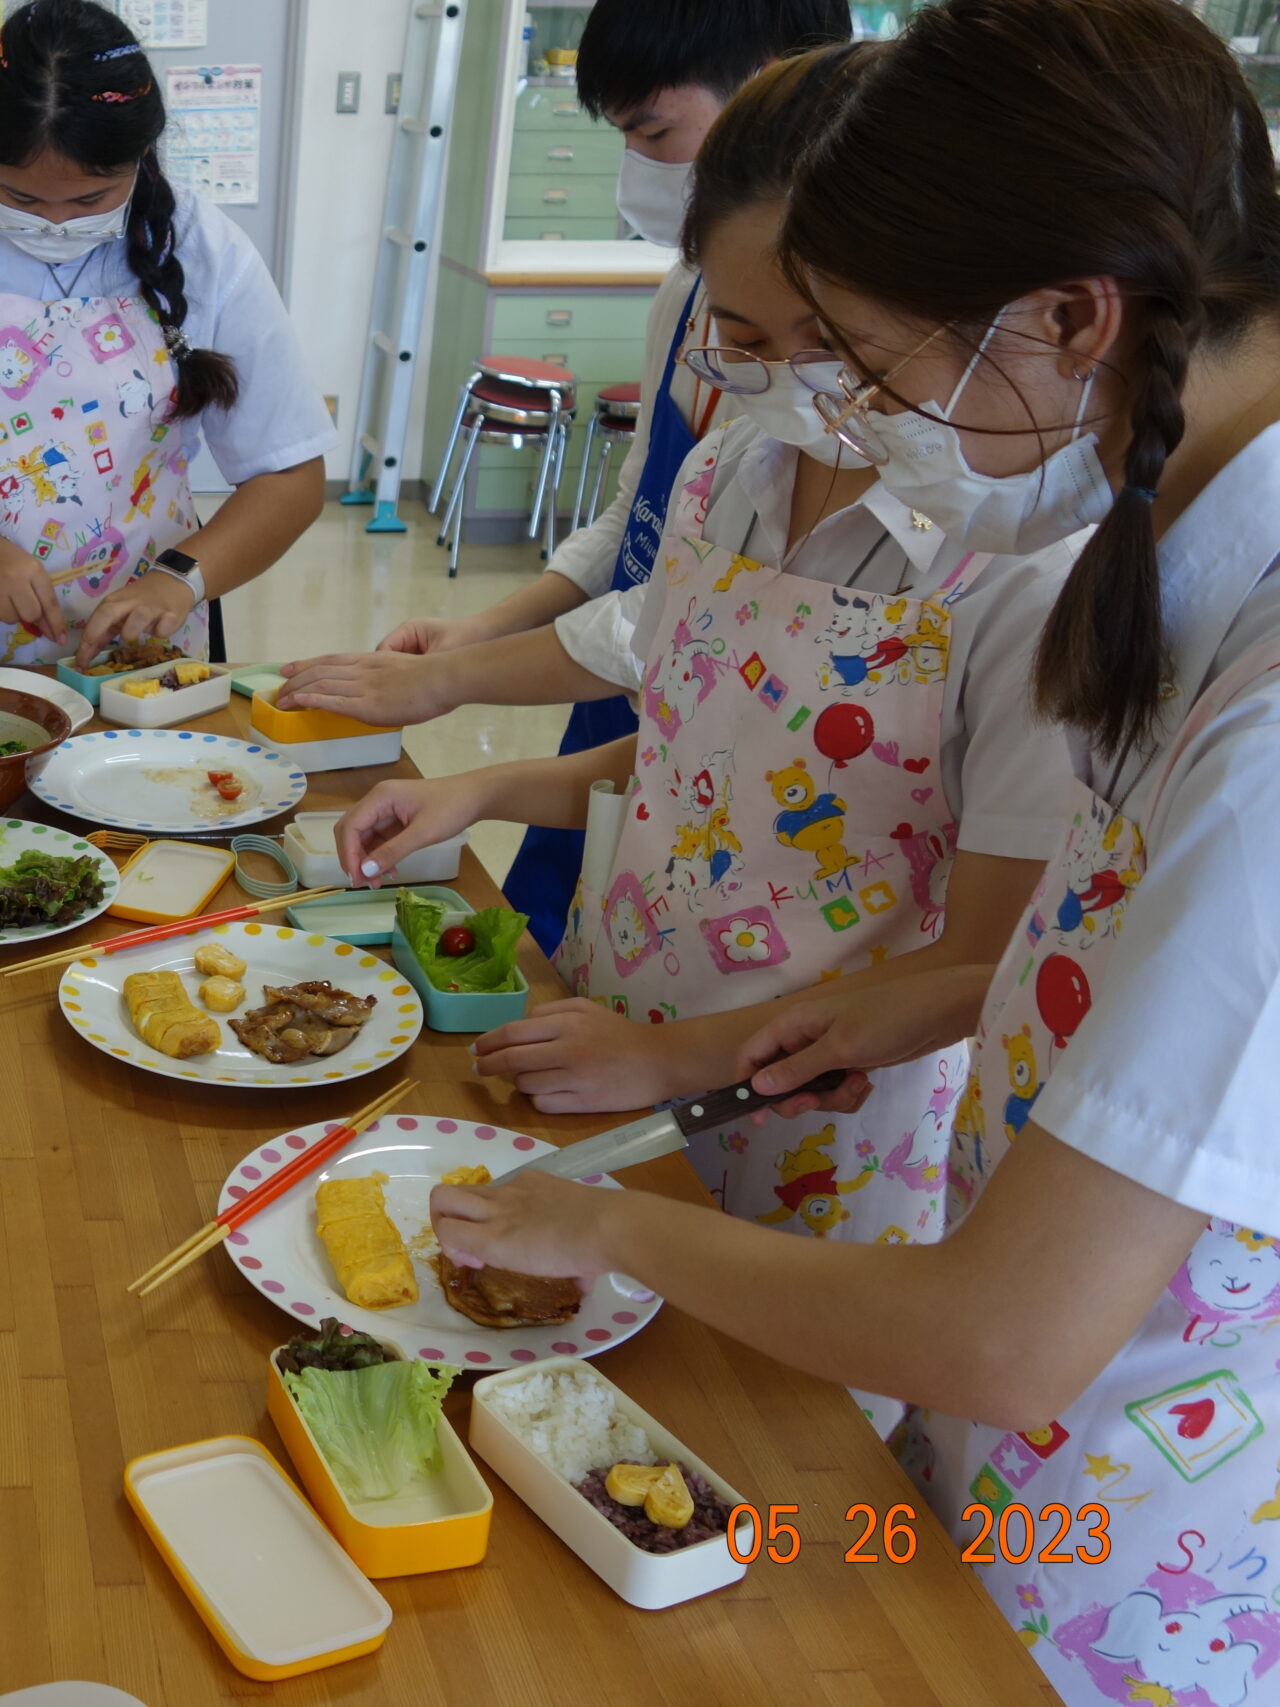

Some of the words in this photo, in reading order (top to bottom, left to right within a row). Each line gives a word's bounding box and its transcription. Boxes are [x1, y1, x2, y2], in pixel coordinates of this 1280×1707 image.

[22, 318, 73, 377] NEKO
[767, 849, 895, 909] KUMA
[638, 871, 681, 977] NEKO
